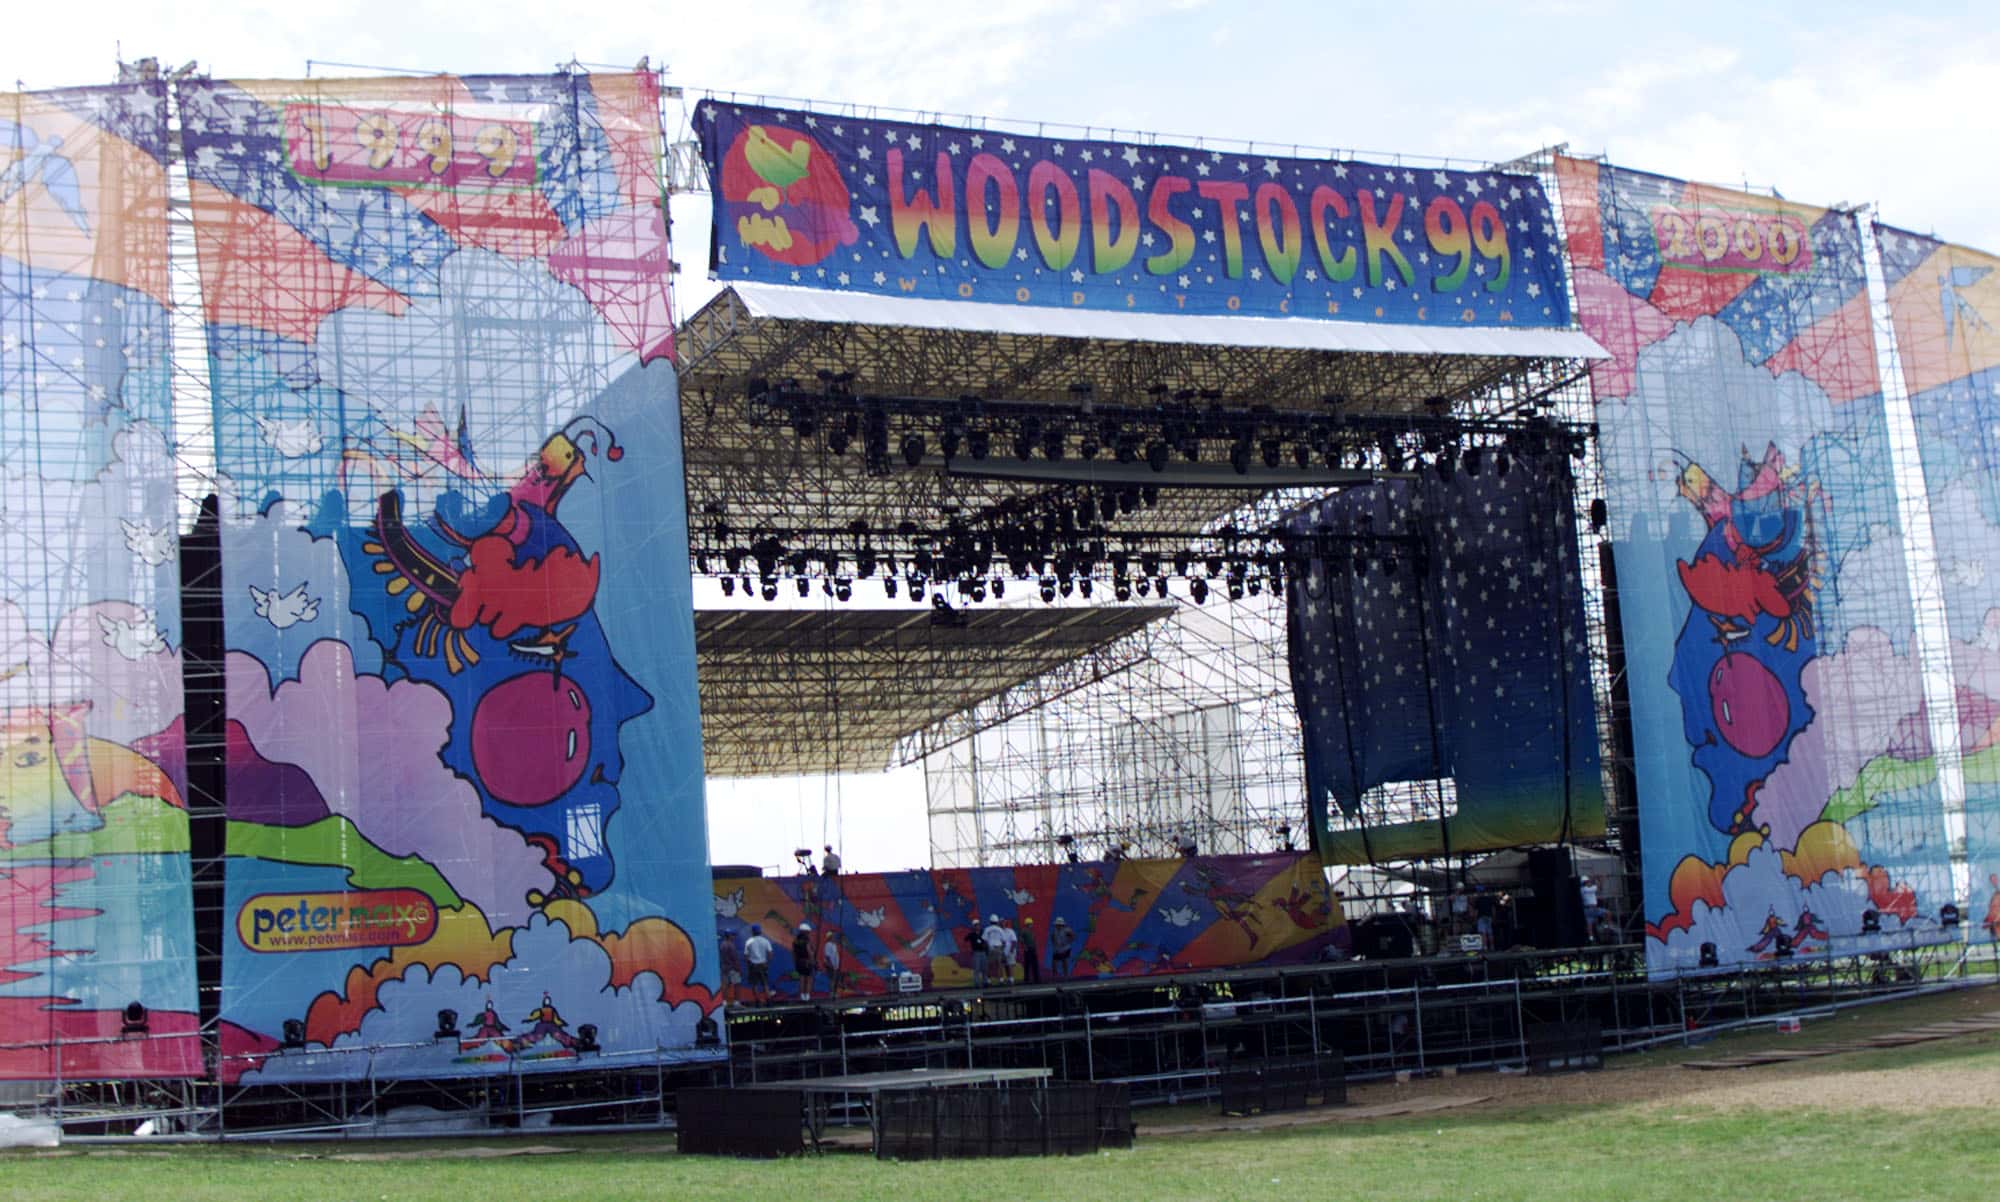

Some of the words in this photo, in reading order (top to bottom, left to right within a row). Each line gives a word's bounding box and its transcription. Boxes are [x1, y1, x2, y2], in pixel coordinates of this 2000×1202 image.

[302, 113, 518, 178] 1999
[886, 148, 1416, 289] WOODSTOCK
[1424, 196, 1511, 293] 99
[1661, 212, 1799, 265] 2000
[253, 899, 344, 945] peter
